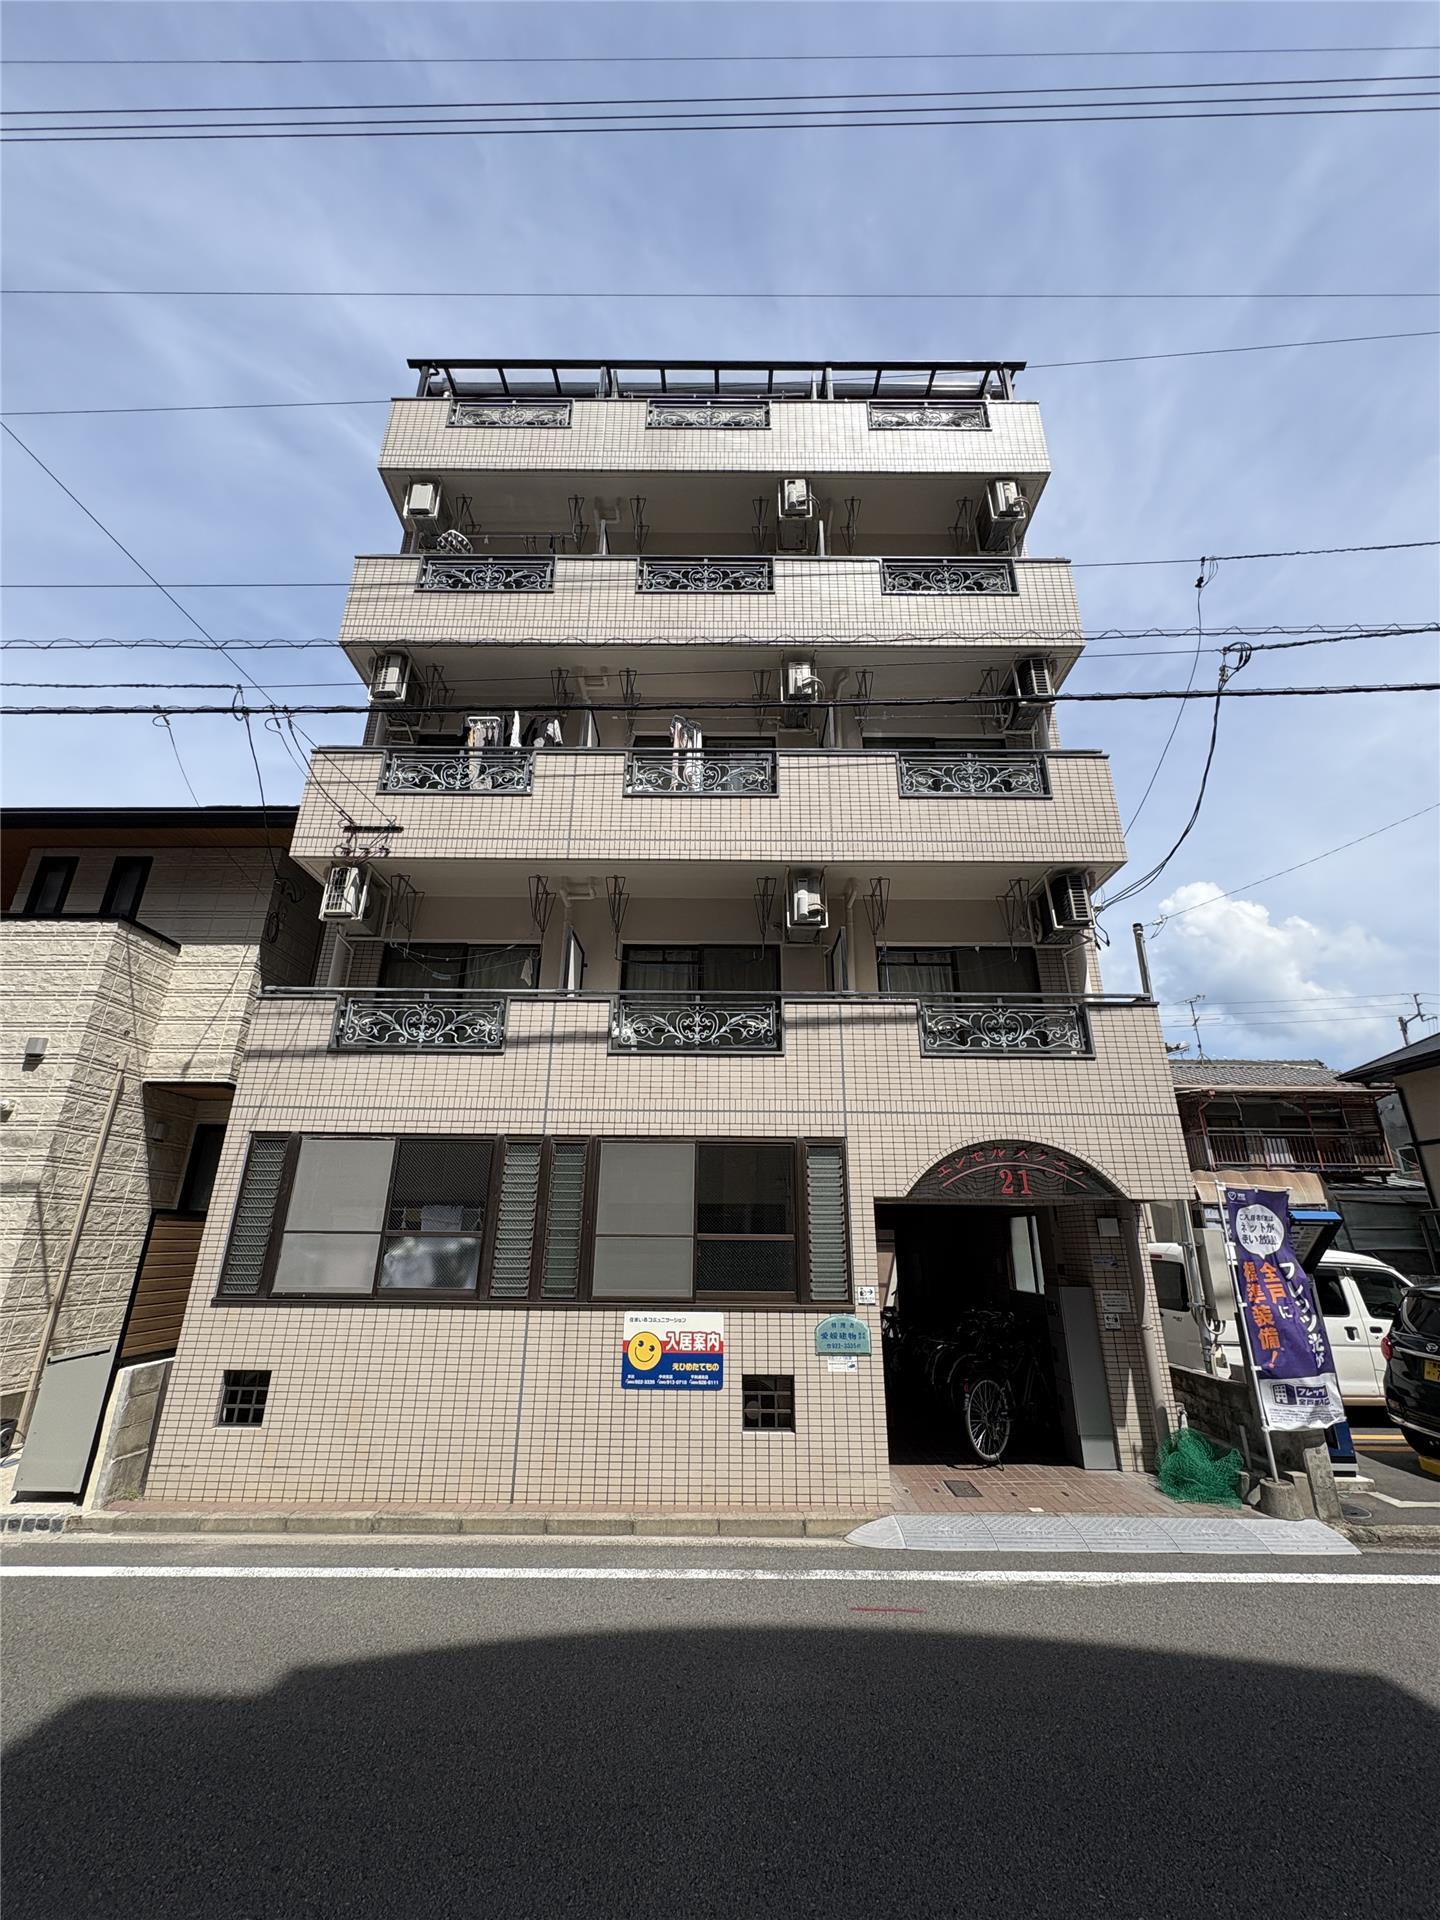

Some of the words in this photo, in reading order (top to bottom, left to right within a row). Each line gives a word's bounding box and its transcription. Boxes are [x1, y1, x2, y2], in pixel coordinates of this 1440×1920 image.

[999, 1169, 1032, 1195] 21
[1240, 1223, 1275, 1233] ネットが
[665, 1331, 720, 1351] 入居案内
